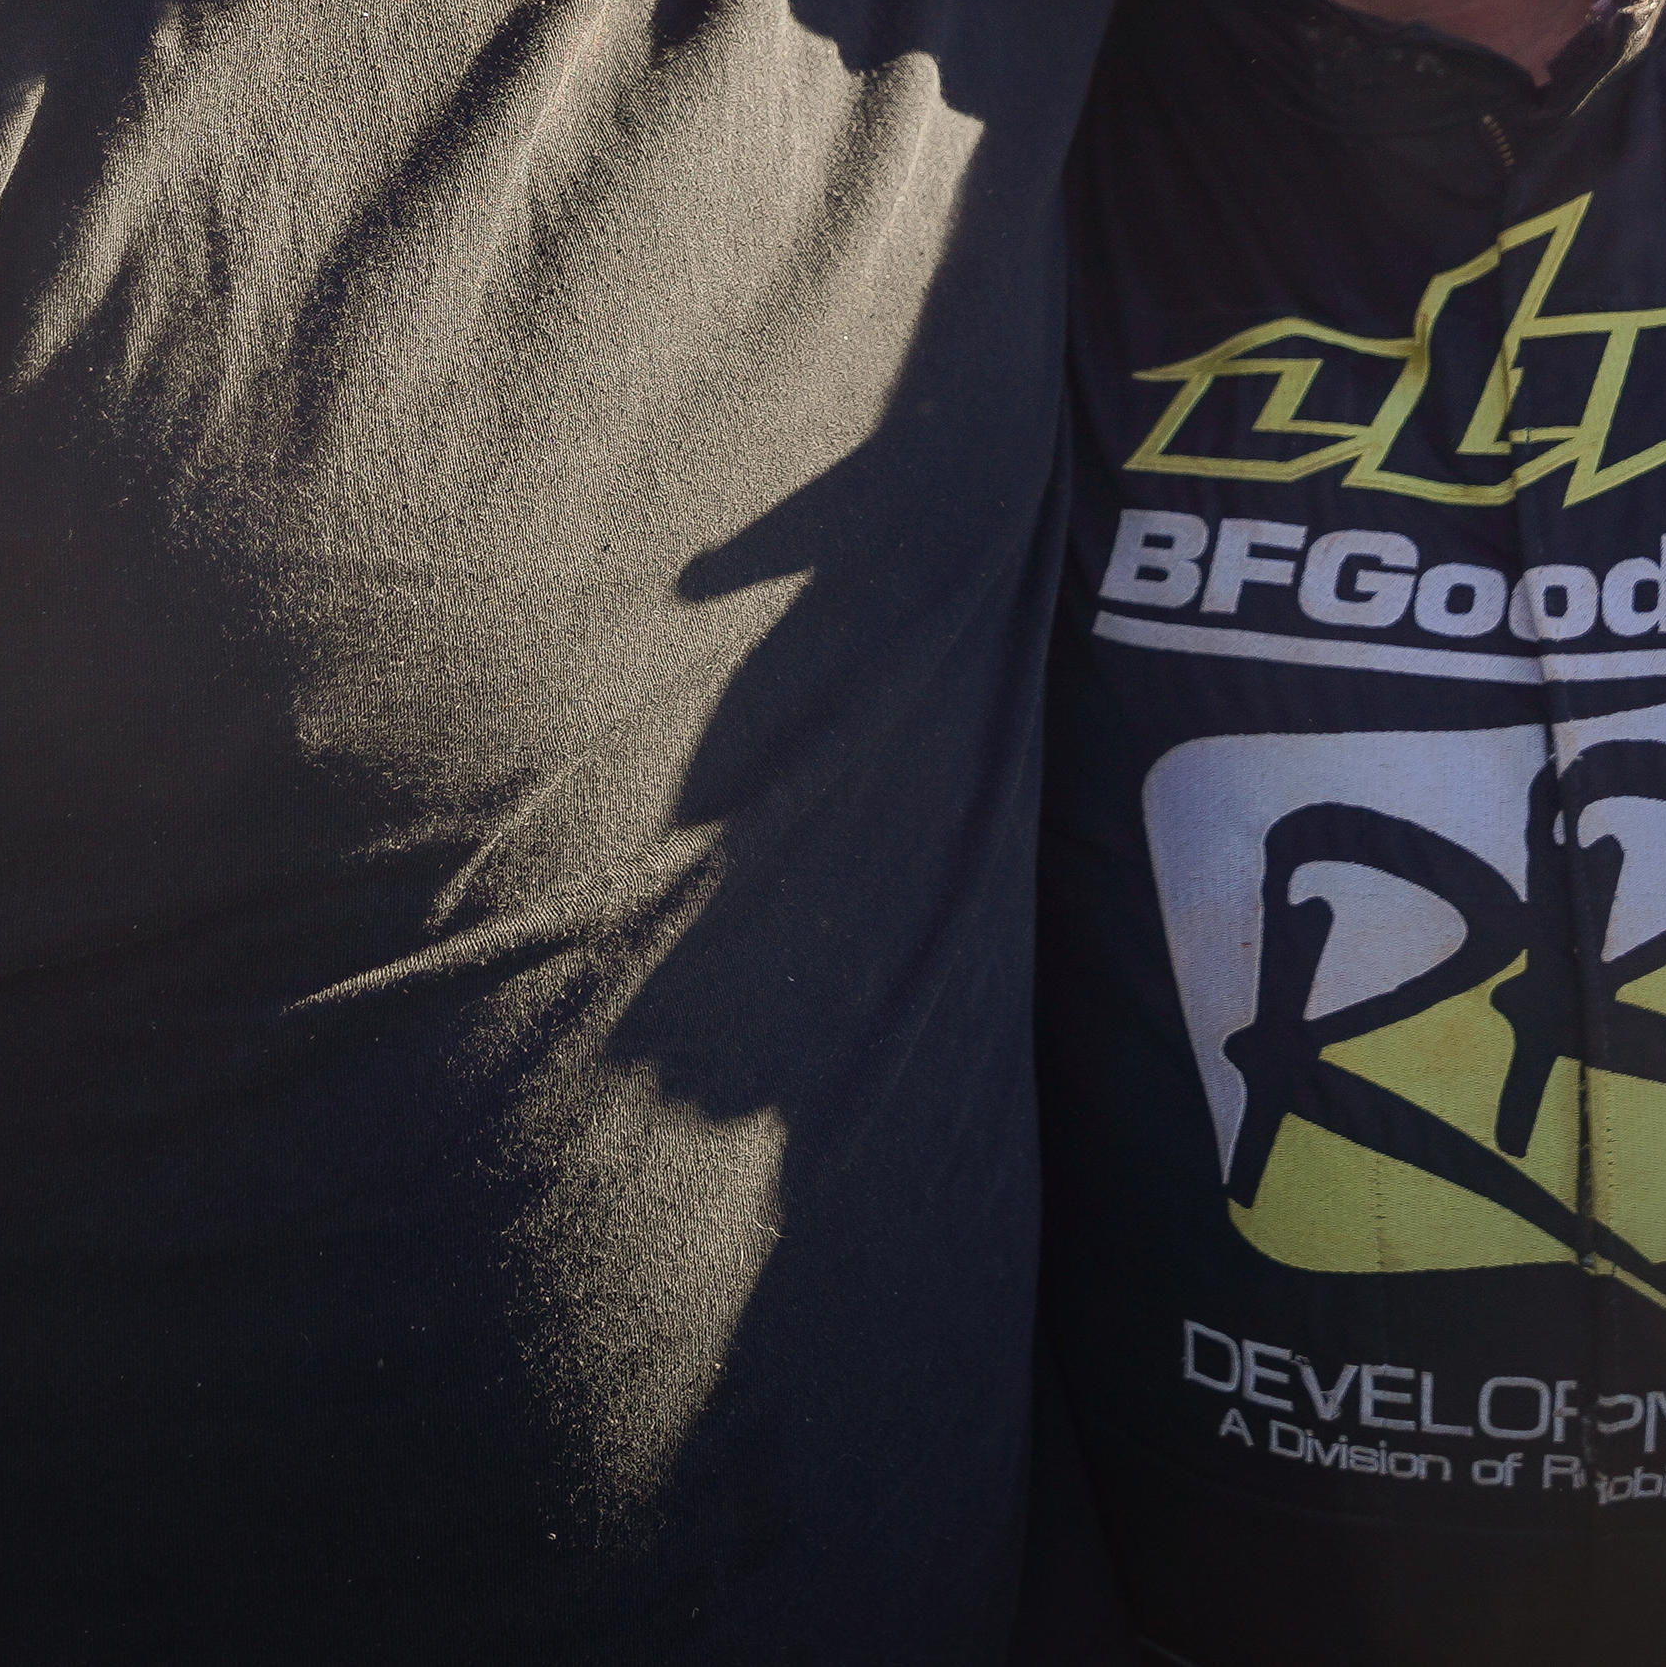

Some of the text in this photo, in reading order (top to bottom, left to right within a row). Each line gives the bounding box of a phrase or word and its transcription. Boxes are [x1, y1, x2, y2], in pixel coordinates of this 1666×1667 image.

[1219, 1407, 1255, 1447] A
[1269, 1419, 1452, 1482] Division
[1472, 1452, 1524, 1488] of
